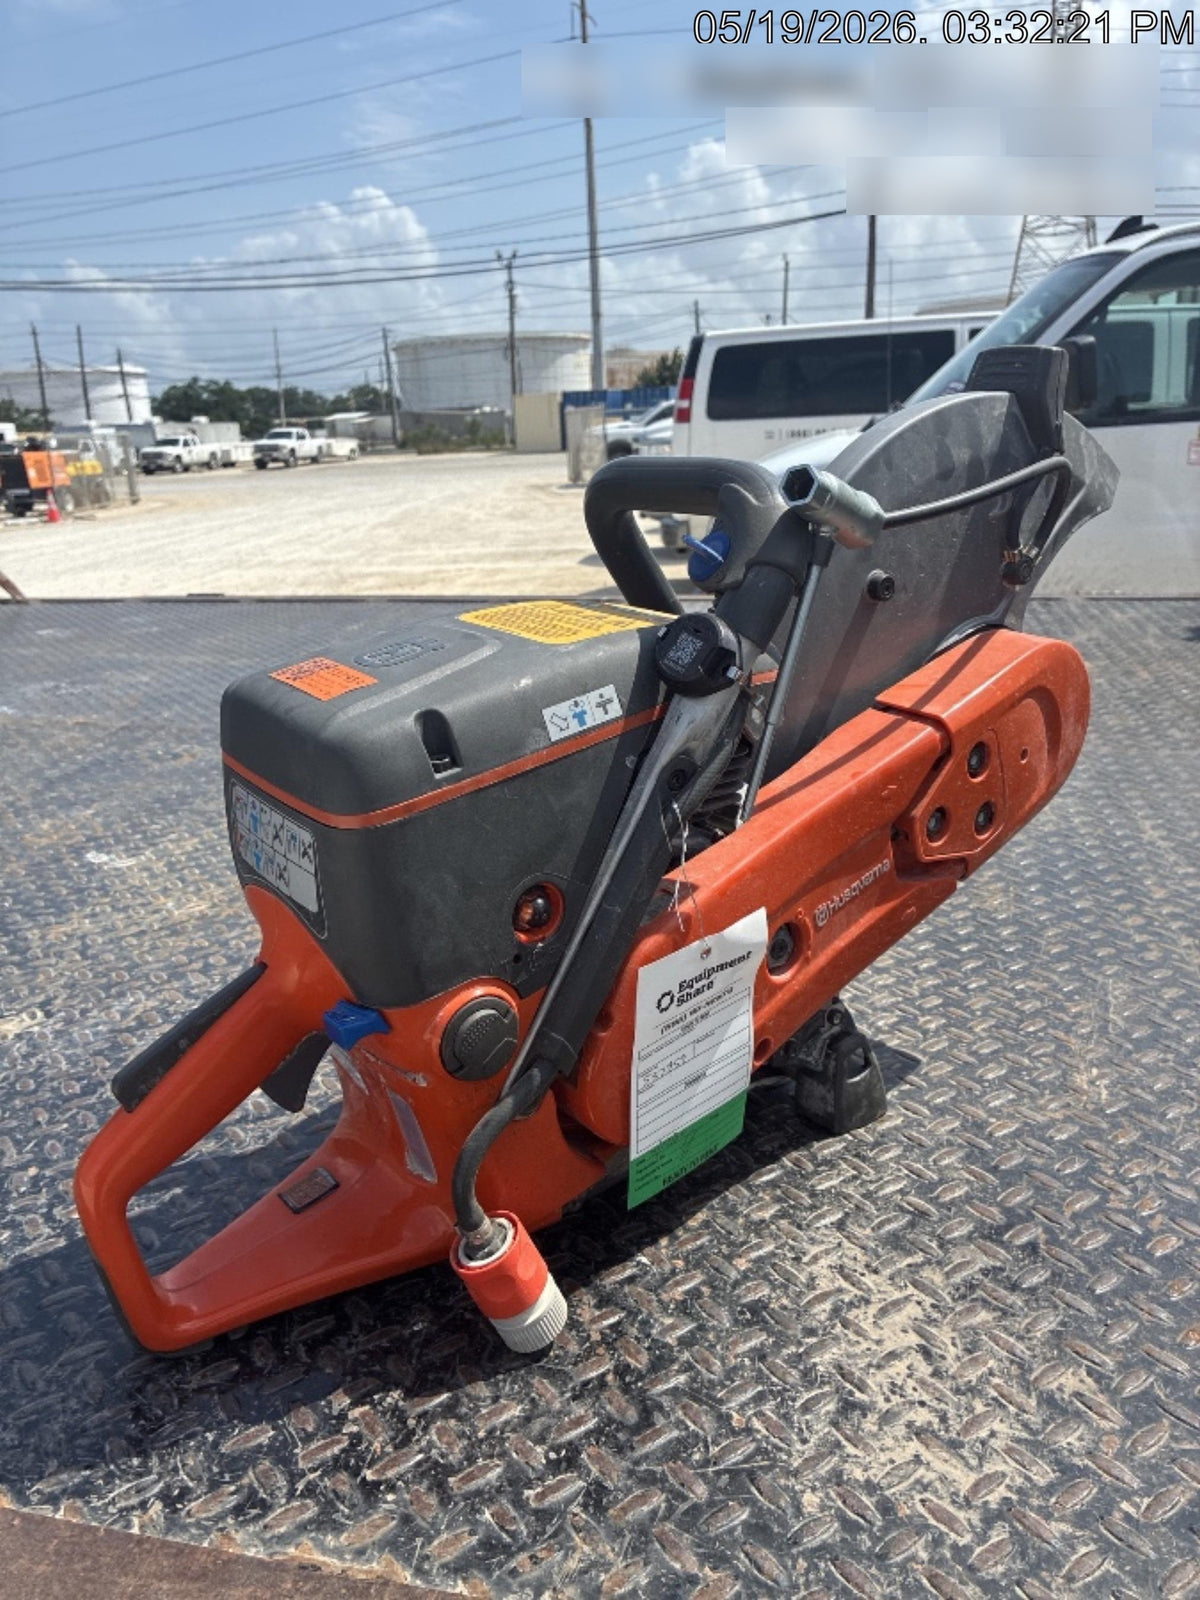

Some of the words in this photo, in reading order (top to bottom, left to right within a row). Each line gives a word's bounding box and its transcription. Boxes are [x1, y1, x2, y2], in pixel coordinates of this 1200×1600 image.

[827, 858, 890, 916] Husqvarna
[676, 980, 714, 1007] Share
[677, 950, 752, 994] Equipment
